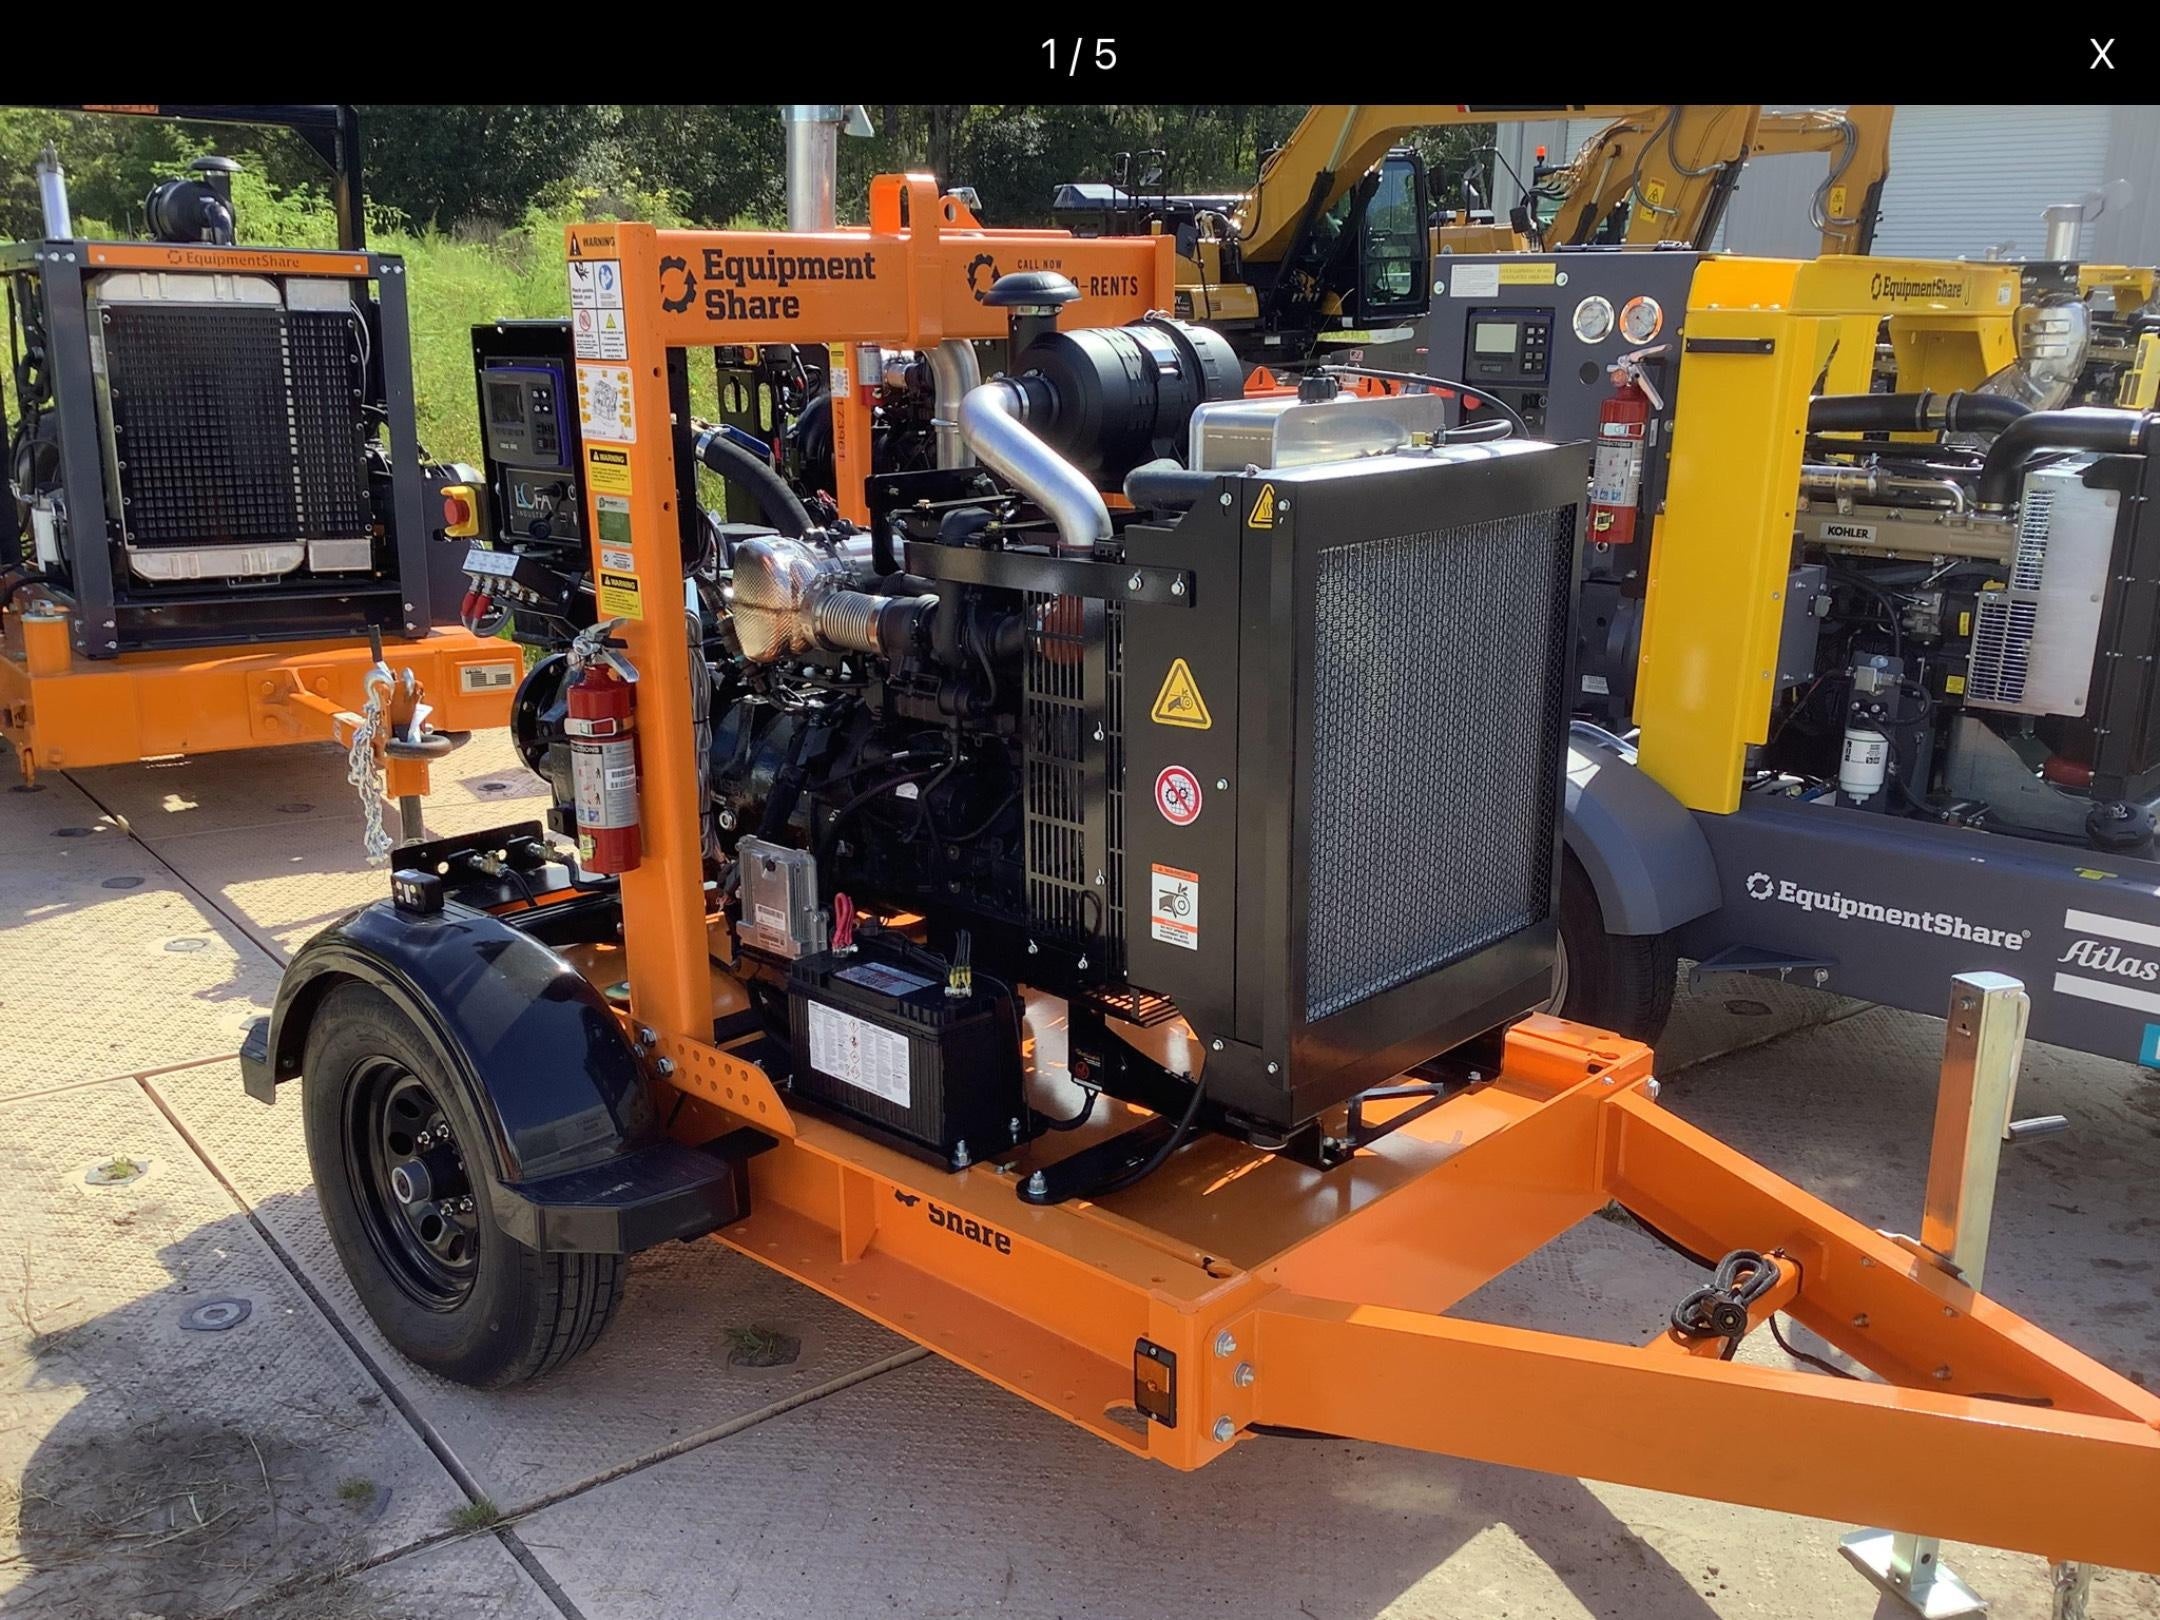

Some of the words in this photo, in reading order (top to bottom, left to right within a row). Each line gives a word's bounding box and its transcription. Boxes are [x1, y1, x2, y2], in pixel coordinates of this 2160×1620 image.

[582, 236, 616, 247] WARNING
[186, 251, 300, 268] EquipmentShare
[1017, 259, 1039, 270] CALL
[1043, 259, 1062, 270] NOW
[702, 249, 876, 287] Equipment
[1882, 275, 1962, 301] EquipmentShare
[704, 288, 800, 321] Share
[599, 453, 625, 464] WARNING
[1827, 525, 1869, 539] KOHLER
[610, 578, 636, 590] WARNING
[2057, 939, 2160, 981] Atlas
